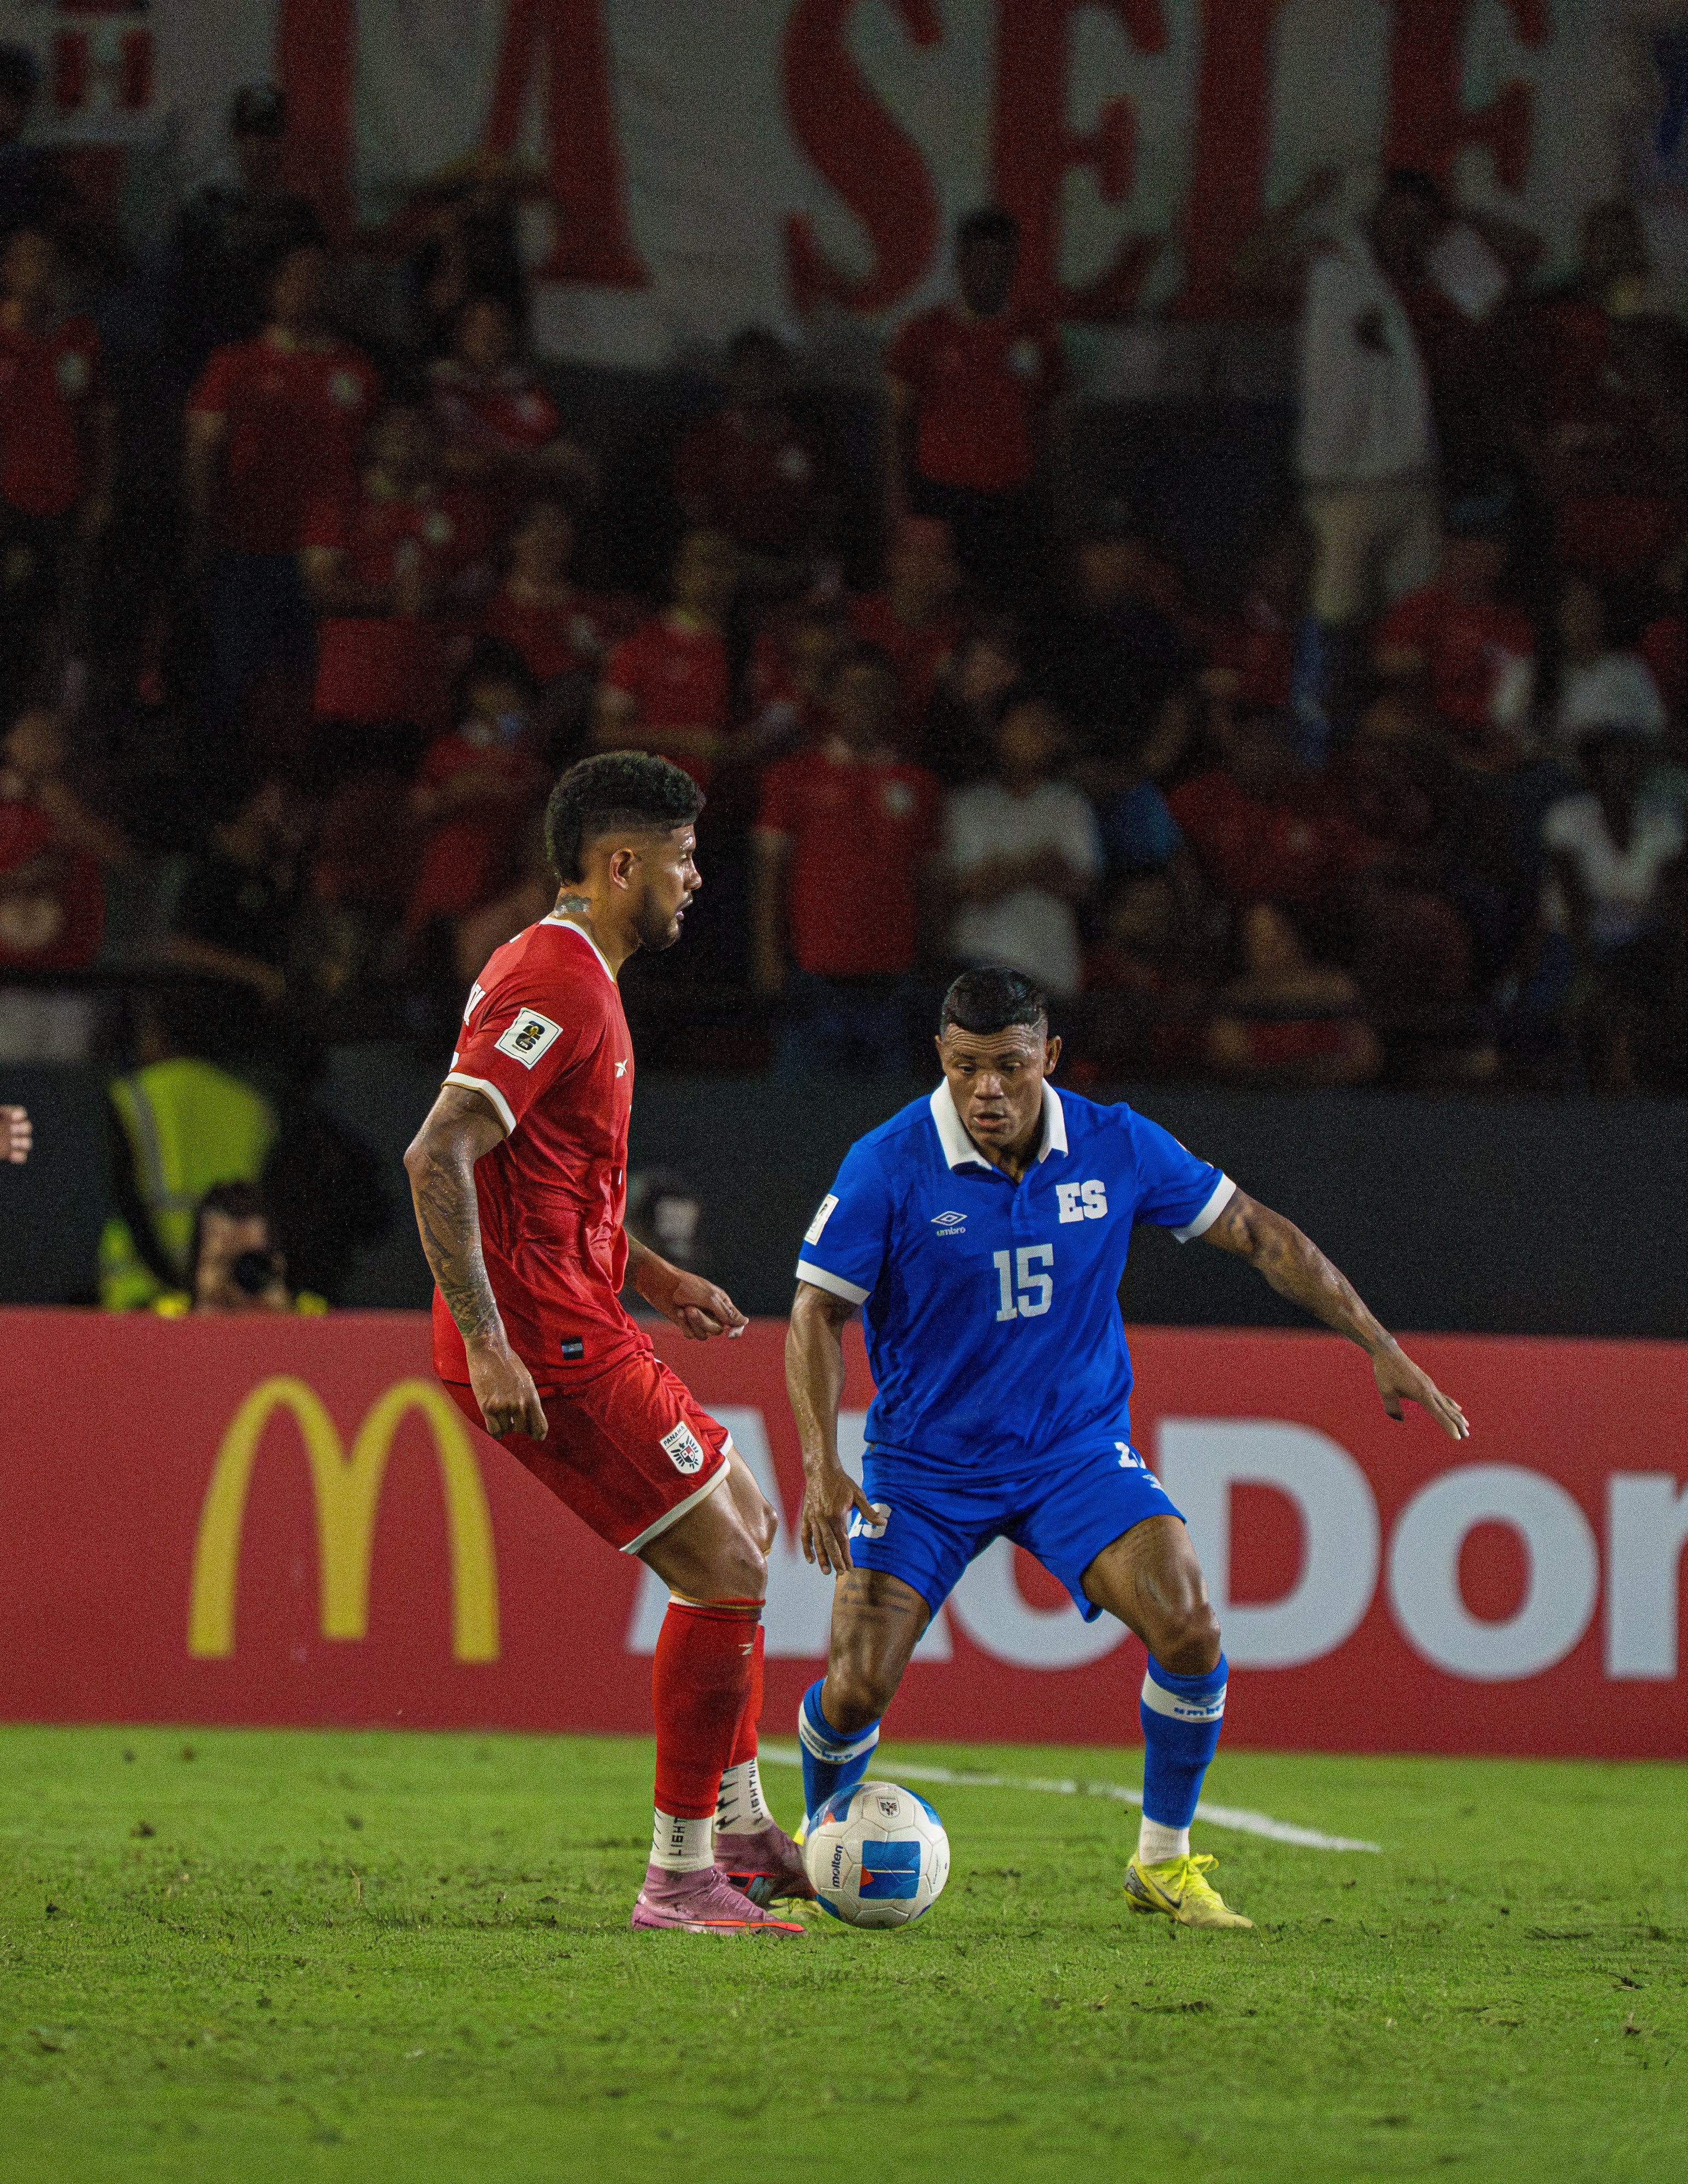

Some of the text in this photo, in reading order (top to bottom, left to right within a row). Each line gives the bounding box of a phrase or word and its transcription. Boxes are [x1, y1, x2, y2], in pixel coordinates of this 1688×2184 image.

[1055, 1179, 1108, 1224] ES
[937, 1226, 966, 1237] umbro
[993, 1243, 1054, 1322] 15
[832, 1844, 844, 1888] molten
